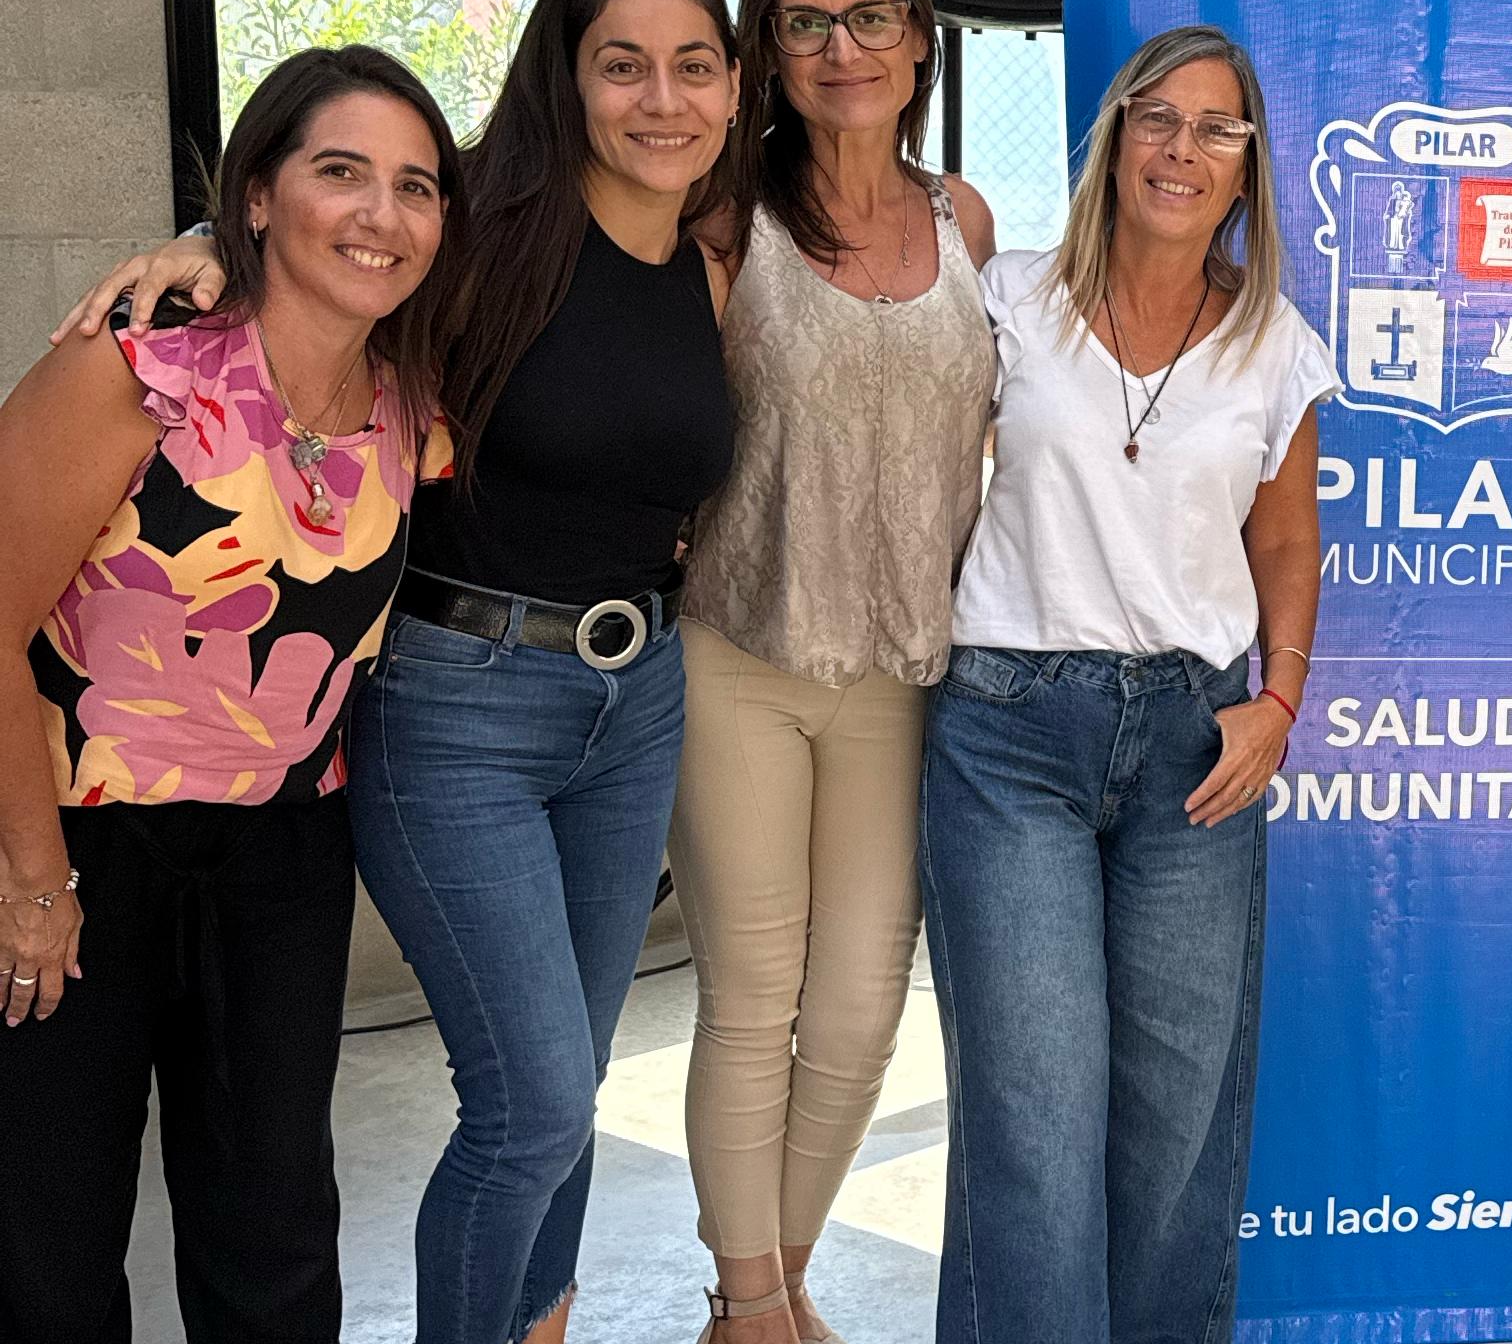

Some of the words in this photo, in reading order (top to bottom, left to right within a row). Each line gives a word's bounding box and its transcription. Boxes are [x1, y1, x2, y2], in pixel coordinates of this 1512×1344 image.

[1415, 130, 1496, 158] PILAR
[1270, 1205, 1313, 1237] tu
[1326, 1194, 1419, 1235] lado
